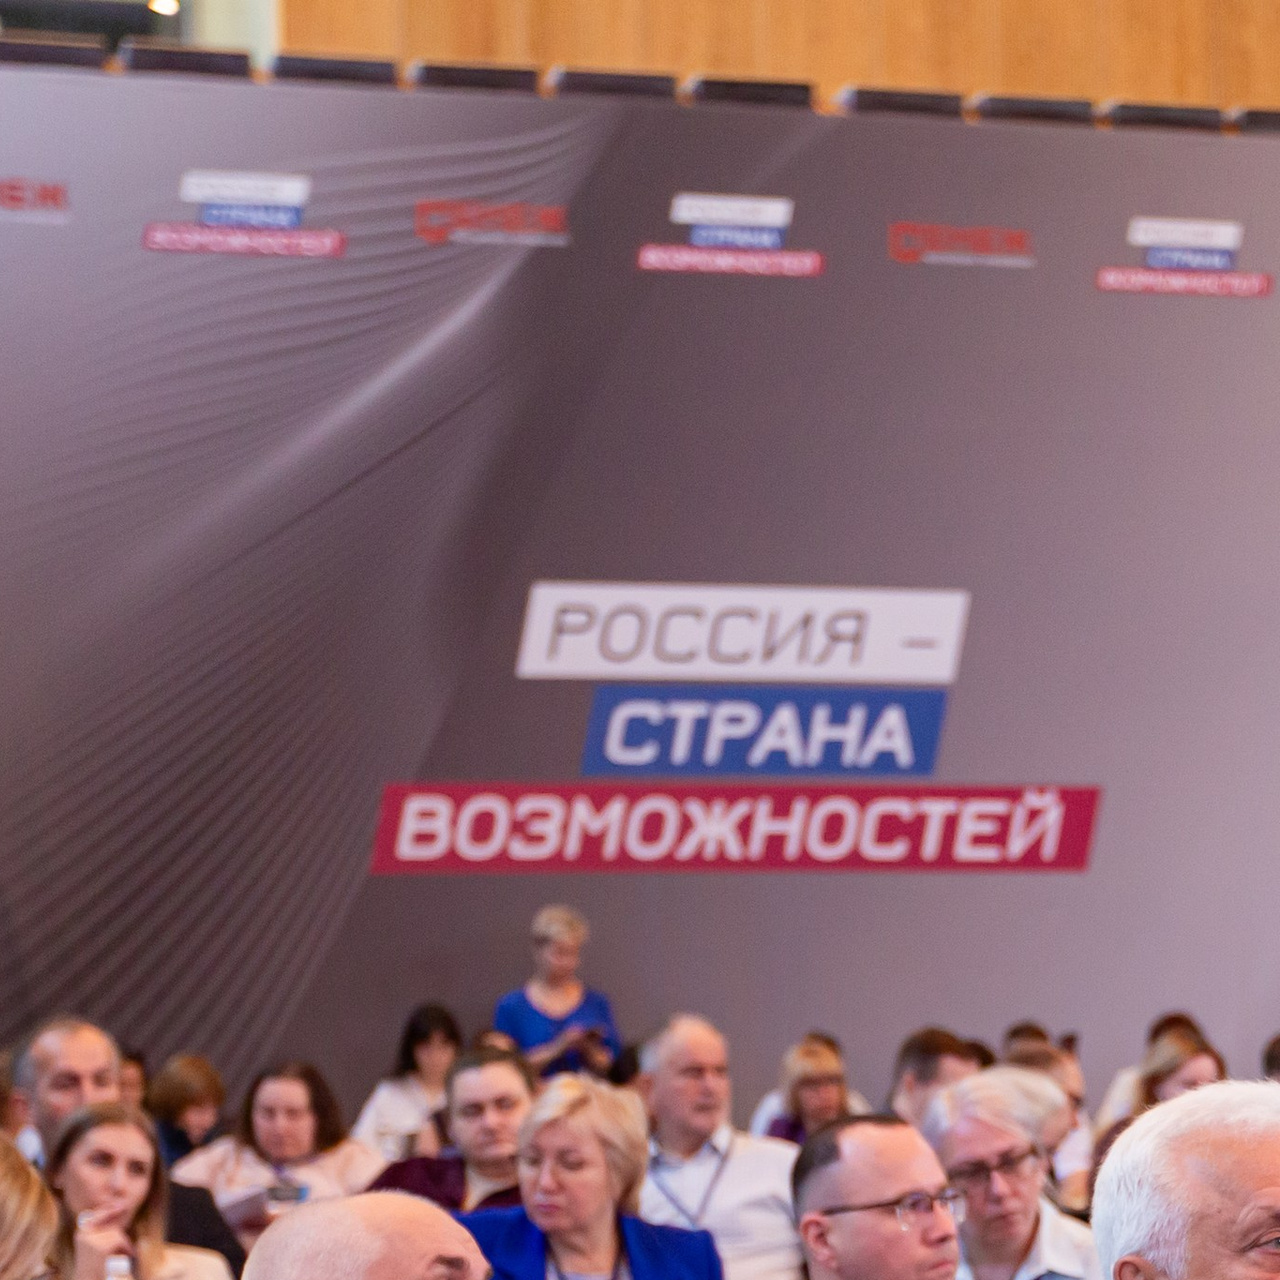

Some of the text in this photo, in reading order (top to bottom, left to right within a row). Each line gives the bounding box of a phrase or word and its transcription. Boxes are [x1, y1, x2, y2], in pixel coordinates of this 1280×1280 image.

[546, 602, 870, 667] РОССИЯ
[603, 699, 915, 768] СТРАНА
[396, 786, 1065, 862] ВОЗМОЖНОСТЕЙ
